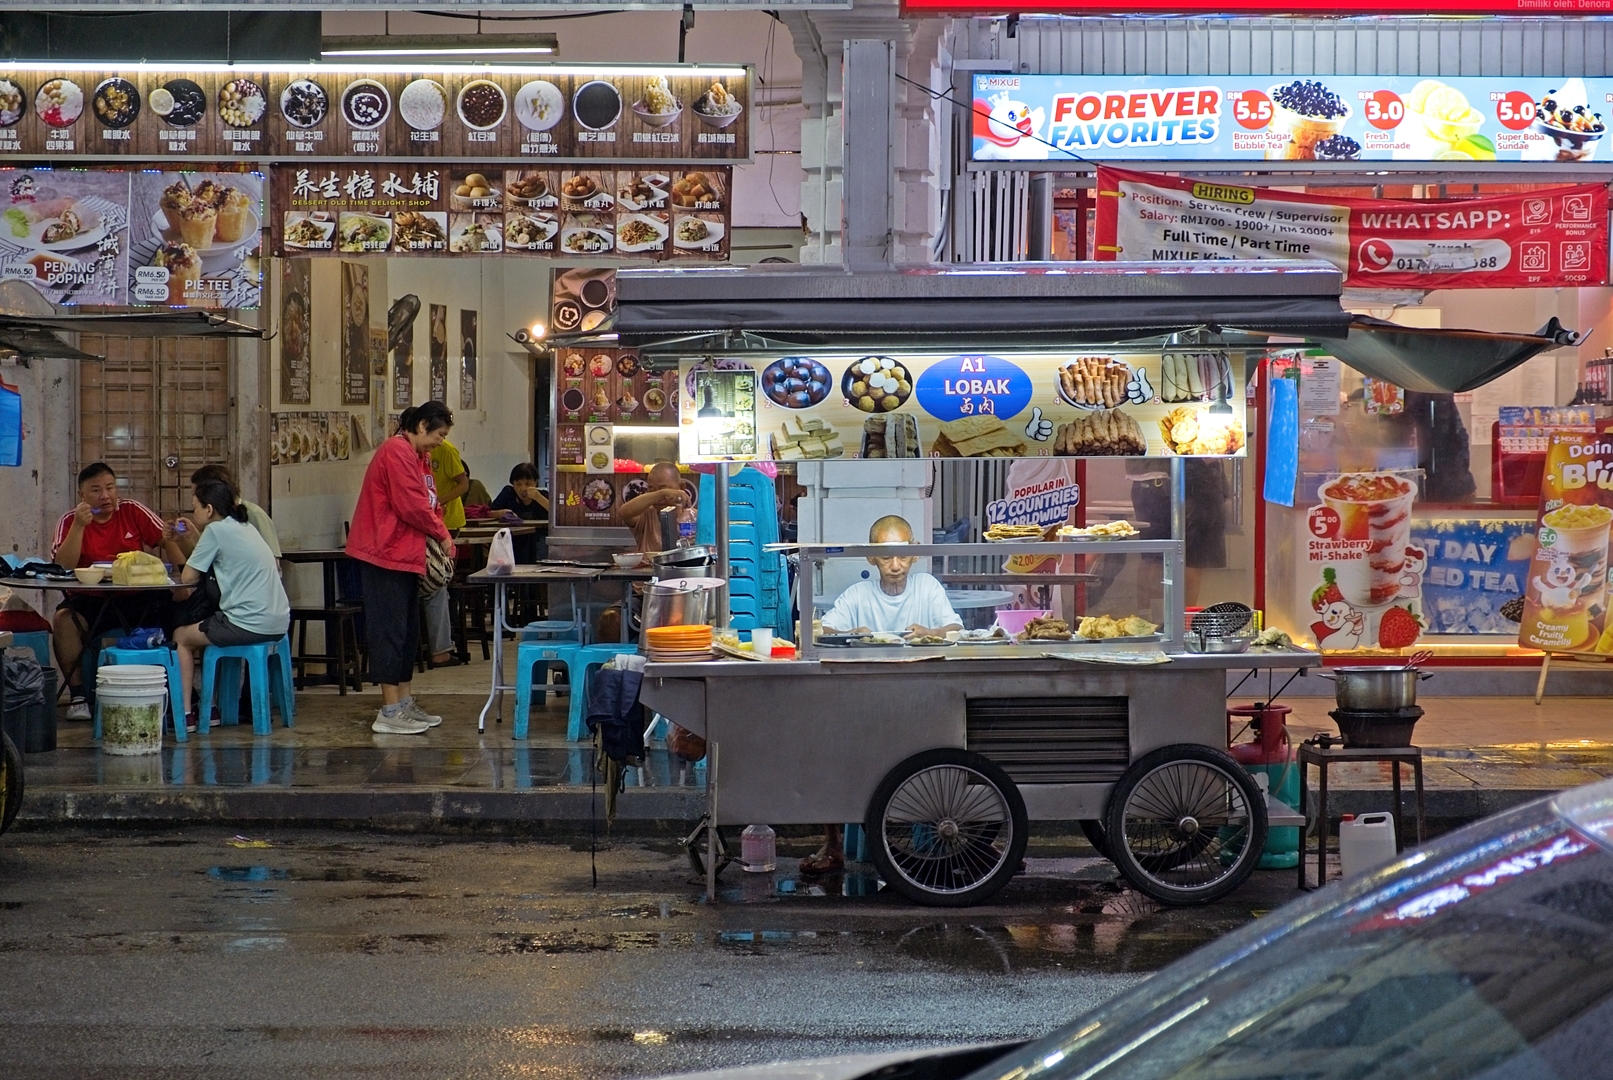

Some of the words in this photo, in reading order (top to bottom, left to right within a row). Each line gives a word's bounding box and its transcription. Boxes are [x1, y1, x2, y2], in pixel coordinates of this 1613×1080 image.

[1578, 0, 1611, 8] Denora
[989, 79, 1019, 87] MIXUE
[1227, 91, 1243, 101] RM
[1358, 91, 1374, 101] RM
[1490, 93, 1506, 101] RM
[1054, 90, 1219, 122] FOREVER
[1236, 101, 1272, 120] 5.5
[1367, 101, 1403, 120] 3.0
[1500, 101, 1535, 120] 5.0
[50, 130, 69, 139] 牛奶
[1051, 118, 1215, 147] FAVORITES
[1265, 133, 1291, 141] Sugar
[1497, 133, 1521, 142] Super
[1497, 142, 1529, 150] Sundae
[292, 168, 440, 200] 养生糖水铺
[1198, 185, 1249, 201] HIRING
[1132, 192, 1183, 207] Position:
[1188, 200, 1232, 213] Service
[1234, 207, 1266, 219] Crew
[1276, 211, 1344, 223] Supervisor
[1140, 209, 1178, 223] Salary:
[1180, 215, 1225, 227] RM1700
[1235, 220, 1270, 231] 1900+
[1280, 225, 1297, 233] RM
[1300, 227, 1334, 236] 2000+
[1361, 209, 1511, 229] WHATSAPP:
[1163, 229, 1190, 243] Full
[1192, 232, 1229, 246] Time
[1240, 236, 1271, 250] Part
[1274, 240, 1311, 254] Time
[1152, 249, 1199, 260] MIXUE
[4, 267, 33, 275] RM6.50
[43, 261, 96, 273] PENANG
[47, 273, 95, 284] POPIAH
[137, 270, 166, 279] RM6.50
[184, 279, 205, 291] PIE
[207, 279, 230, 291] TEE
[137, 288, 165, 296] RM6.50
[960, 357, 986, 373] A1
[944, 379, 1011, 395] LOBAK
[765, 400, 772, 408] 2
[843, 398, 850, 407] 3
[1053, 396, 1061, 405] 4
[1154, 396, 1161, 405] 5
[1202, 395, 1209, 404] 6
[928, 451, 940, 459] 10
[1038, 448, 1049, 456] 11
[1160, 448, 1173, 456] 12
[1014, 481, 1054, 499] POPULAR
[1055, 478, 1065, 488] IN
[989, 502, 1007, 522] 12
[1008, 486, 1079, 517] COUNTRIES
[1540, 533, 1557, 542] 5.0
[1309, 540, 1372, 550] Strawberry
[1309, 550, 1363, 561] Mi-Shake
[1444, 540, 1497, 565] DAY
[1018, 554, 1033, 567] 2.00
[1469, 569, 1519, 593] TEA
[1537, 622, 1569, 633] Creamy
[1539, 630, 1564, 639] Fruity
[1530, 635, 1572, 646] Caramelly
